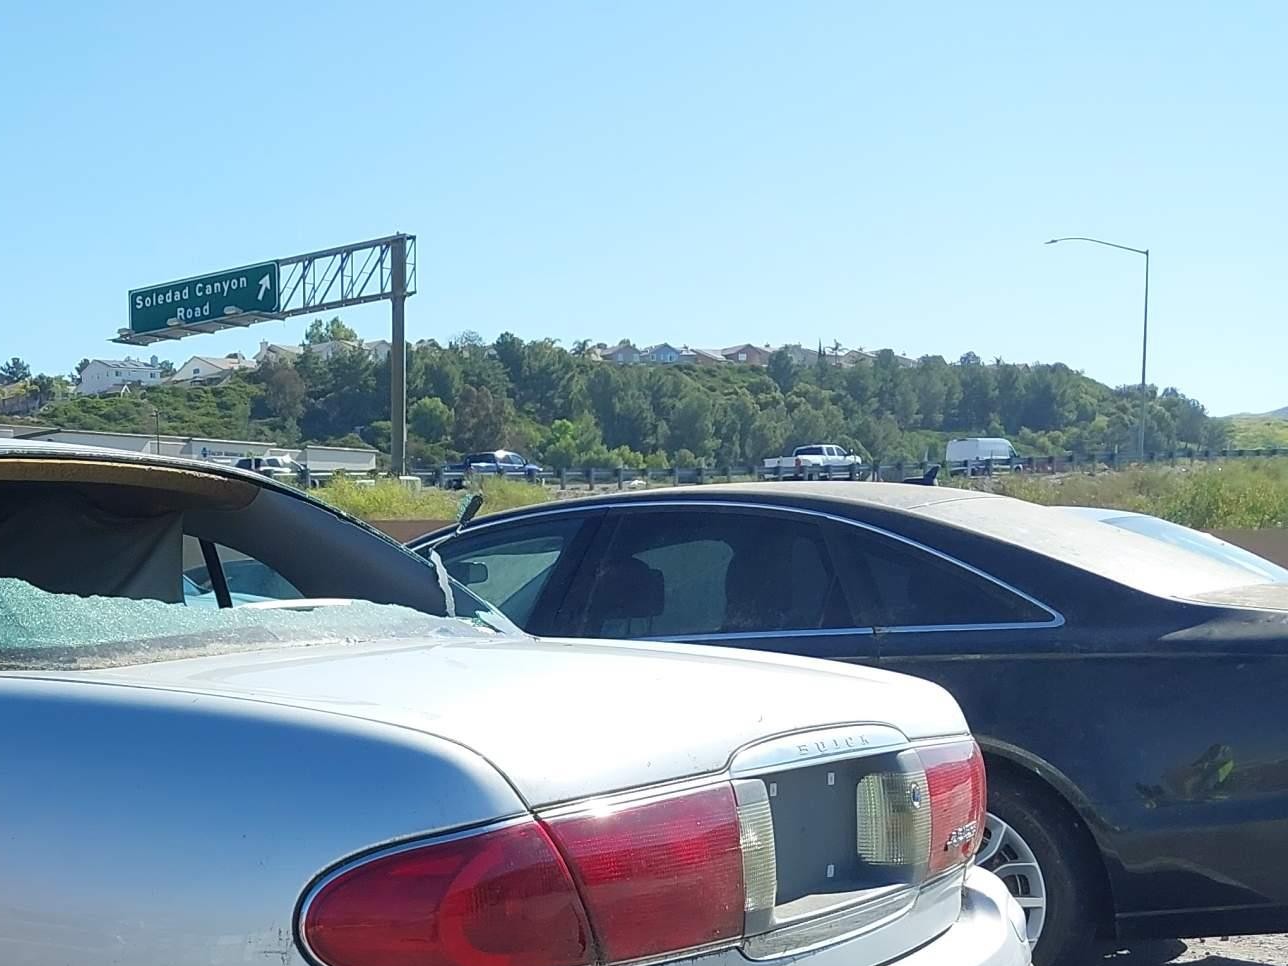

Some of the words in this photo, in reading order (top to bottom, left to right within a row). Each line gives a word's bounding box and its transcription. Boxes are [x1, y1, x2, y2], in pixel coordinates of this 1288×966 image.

[135, 287, 189, 309] Soledad
[196, 277, 248, 297] Canyon
[177, 302, 210, 320] Road
